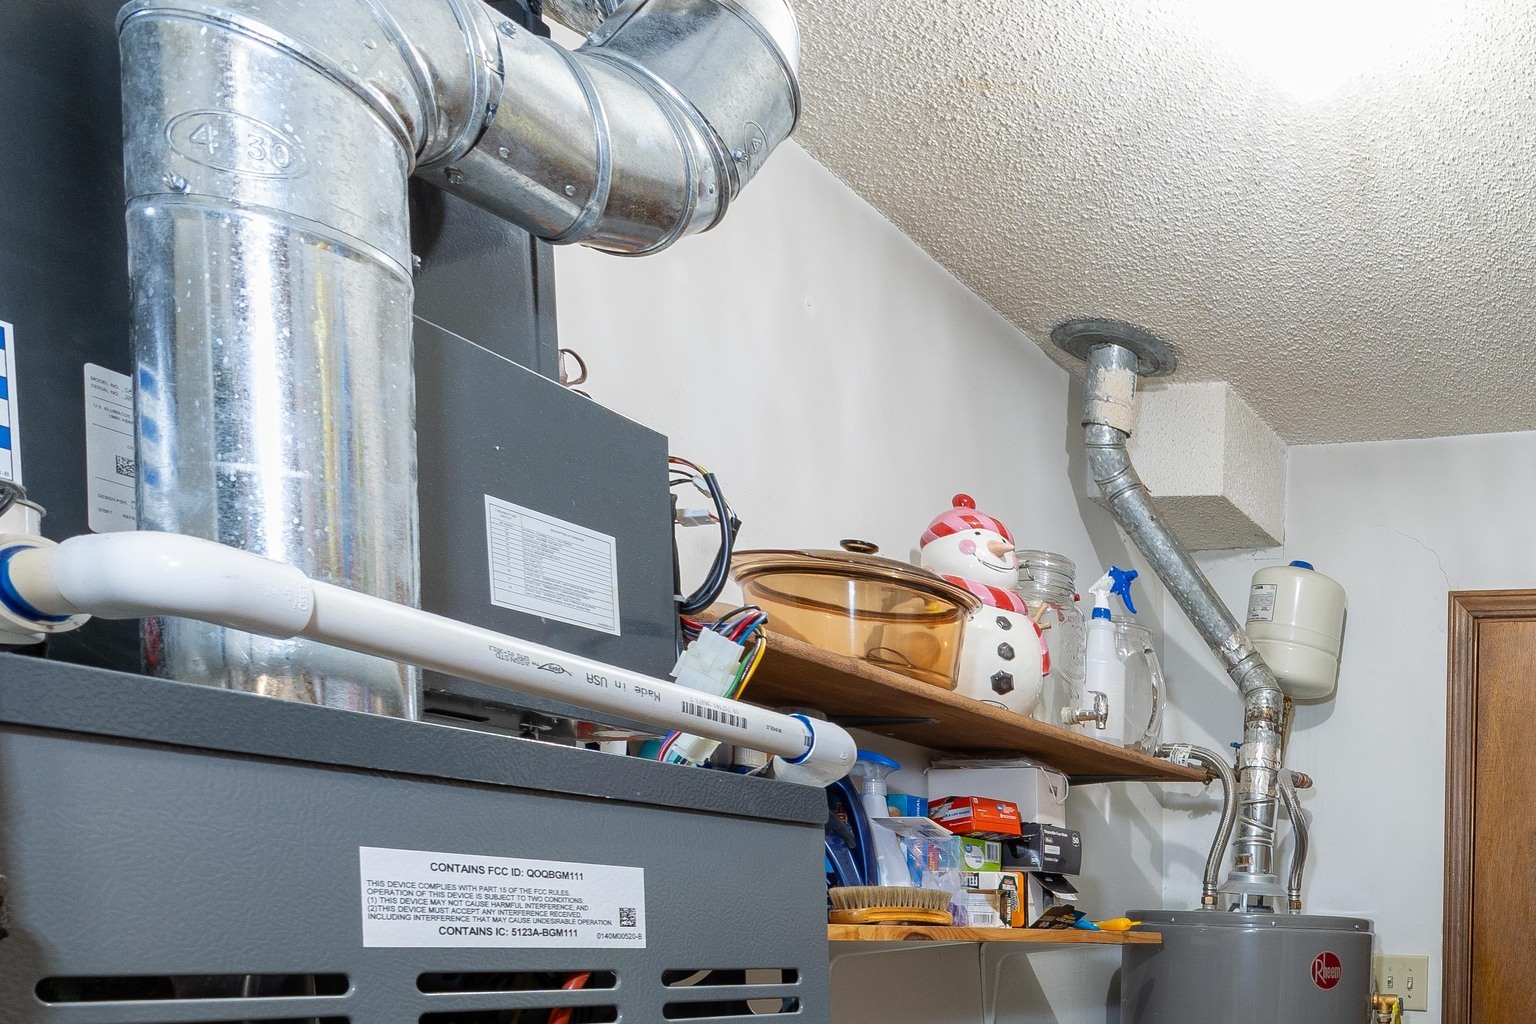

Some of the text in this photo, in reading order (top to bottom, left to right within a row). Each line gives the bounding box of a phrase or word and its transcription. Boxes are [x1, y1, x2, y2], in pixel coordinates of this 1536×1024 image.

[586, 672, 662, 702] Made in USA
[430, 862, 584, 880] CONTAINS FCC ID: QOQBGM111
[366, 880, 386, 888] THIS
[387, 880, 416, 890] DEVICE
[418, 882, 456, 890] COMPLIES
[458, 884, 478, 892] WITH
[479, 885, 498, 894] PART
[367, 888, 414, 898] OPERATION
[416, 890, 426, 898] OF
[447, 891, 474, 900] DEVICE
[484, 893, 518, 902] SUBJECT
[397, 905, 428, 914] DEVICE
[451, 908, 480, 916] ACCEPT
[481, 908, 496, 916] ANY
[498, 909, 548, 918] INTERFERENCE
[399, 897, 428, 906] DEVICE
[465, 900, 490, 908] CAUSE
[491, 902, 524, 910] HARMFUL
[576, 904, 588, 912] AND
[367, 913, 412, 922] INCLUDING
[413, 914, 470, 922] INTERFERENCE
[492, 916, 506, 924] MAY
[532, 917, 578, 926] UNDESIRABLE
[439, 926, 578, 938] CONTAINS IC: 5123A-BGM111
[1315, 953, 1340, 984] Rheem
